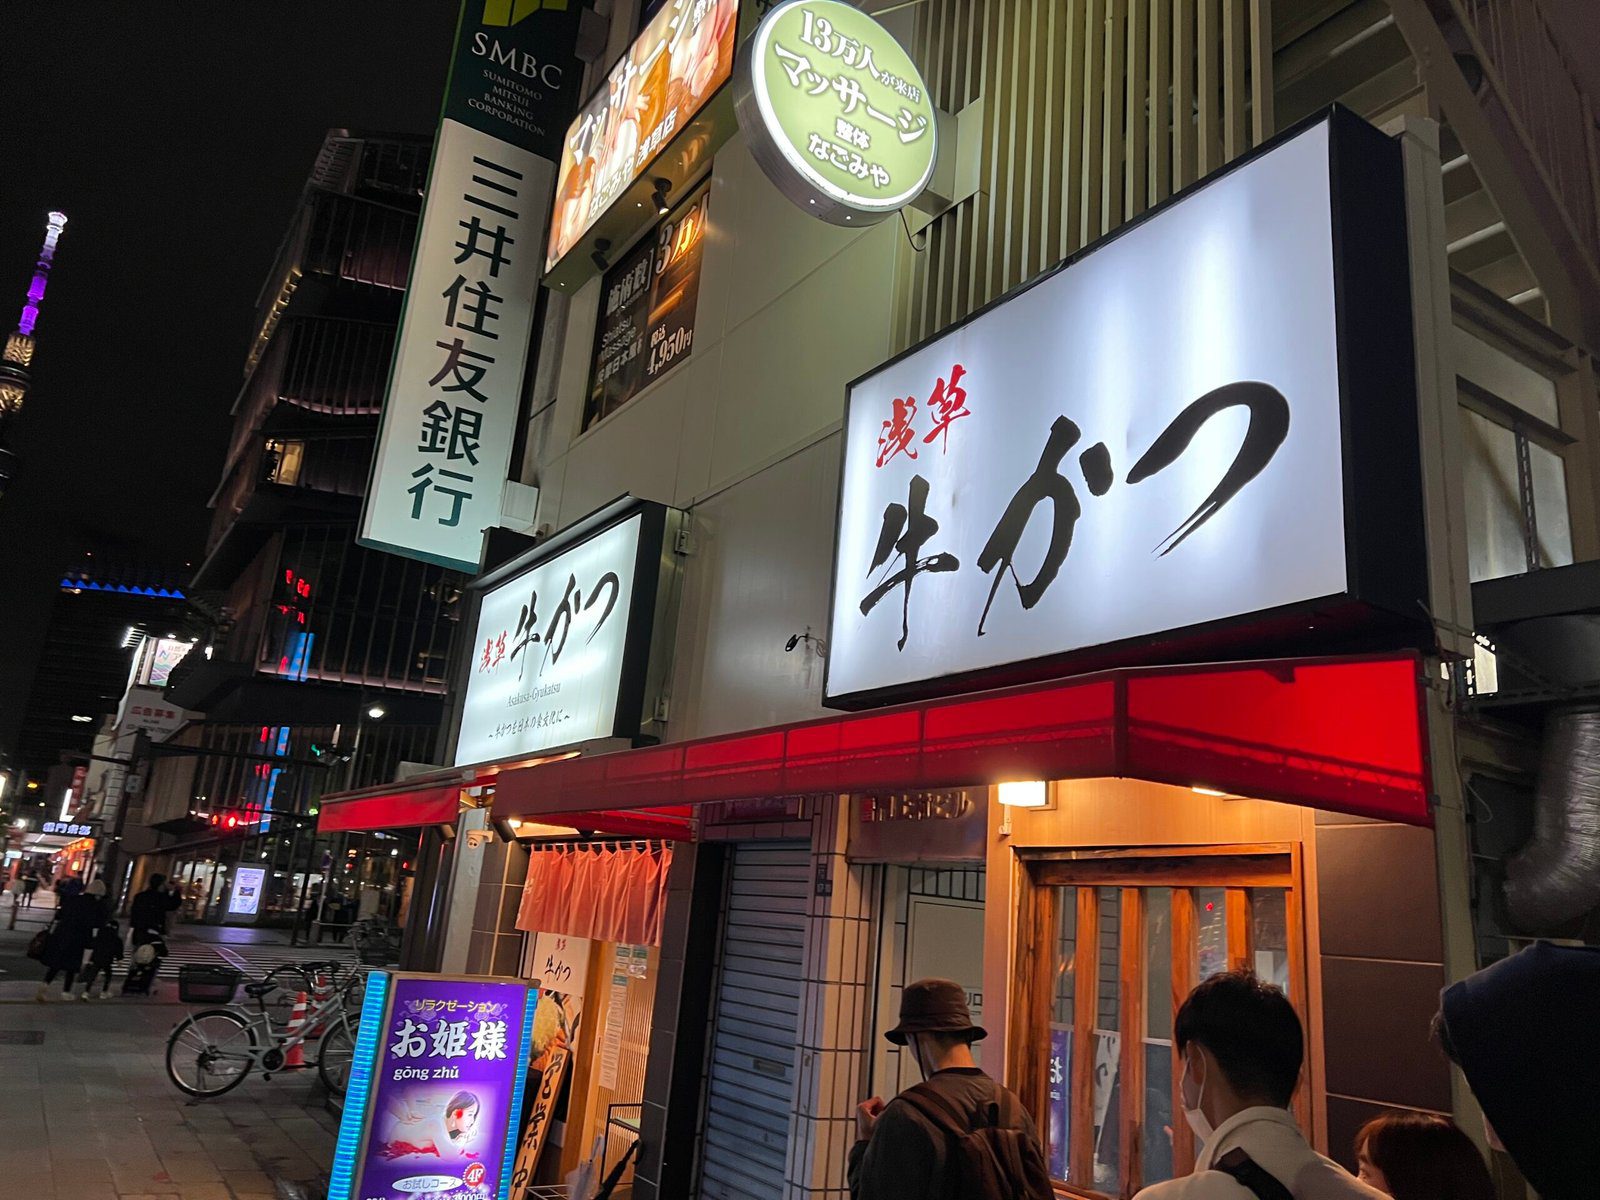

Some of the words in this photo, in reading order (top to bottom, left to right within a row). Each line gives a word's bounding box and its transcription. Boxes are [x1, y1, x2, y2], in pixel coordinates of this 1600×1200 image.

[471, 32, 562, 90] SMBC
[483, 69, 543, 100] SUMITOMO
[492, 86, 529, 108] MITSUI
[774, 42, 927, 144] マッサージ
[468, 98, 545, 136] CORPORATION
[484, 93, 534, 120] BANKING
[835, 117, 870, 150] 整体
[808, 132, 890, 188] なごみや
[408, 156, 523, 527] 三井住友銀行
[875, 364, 971, 468] 浅草
[859, 380, 1291, 652] 牛かつ
[479, 630, 508, 675] 浅草
[510, 571, 620, 682] 牛かつ
[414, 999, 498, 1013] リラクゼーション
[390, 1018, 507, 1061] お姫様
[393, 1066, 430, 1080] gōng
[402, 1177, 458, 1190] お試しコース
[467, 1168, 484, 1183] 4F
